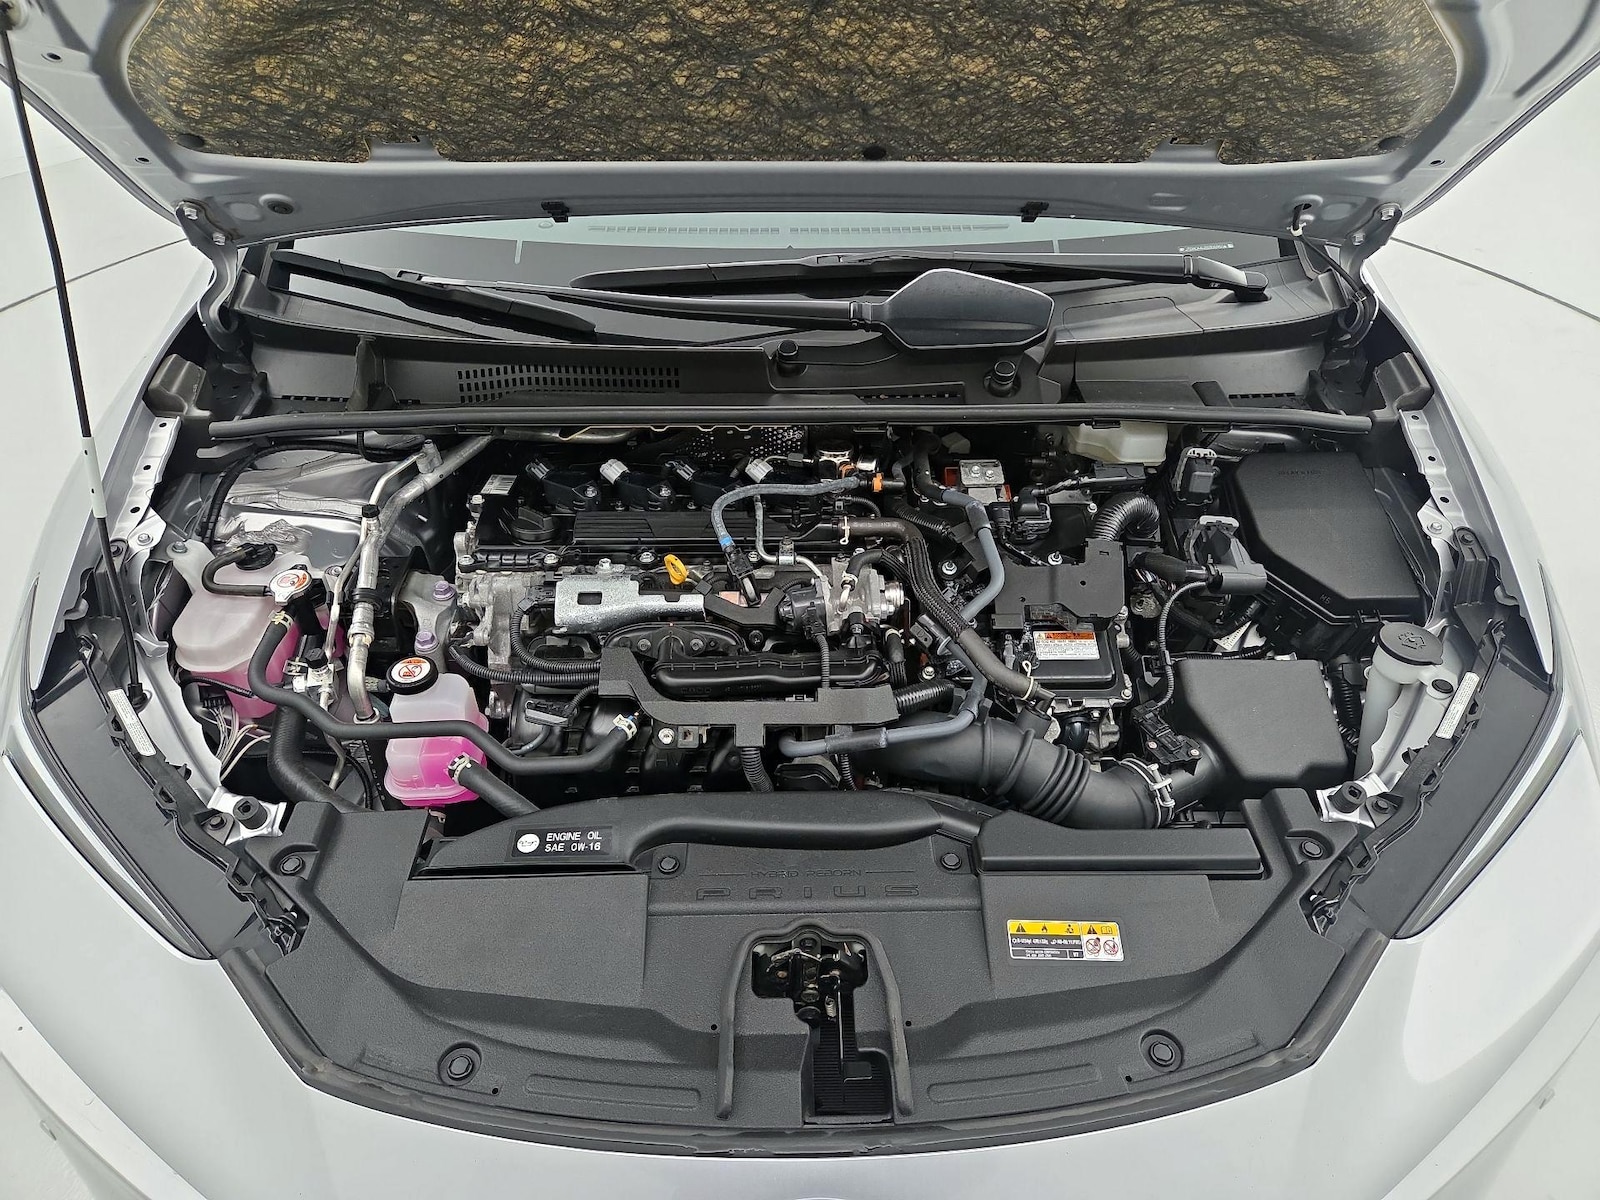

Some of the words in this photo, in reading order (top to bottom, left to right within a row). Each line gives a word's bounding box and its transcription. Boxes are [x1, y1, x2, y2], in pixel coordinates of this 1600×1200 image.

[546, 831, 581, 842] ENGINE
[587, 831, 602, 840] OIL
[544, 843, 565, 852] SAE
[571, 842, 601, 852] 0W-16
[751, 870, 799, 878] HYBRID
[806, 868, 861, 877] REBORN
[696, 884, 919, 900] PRIUS
